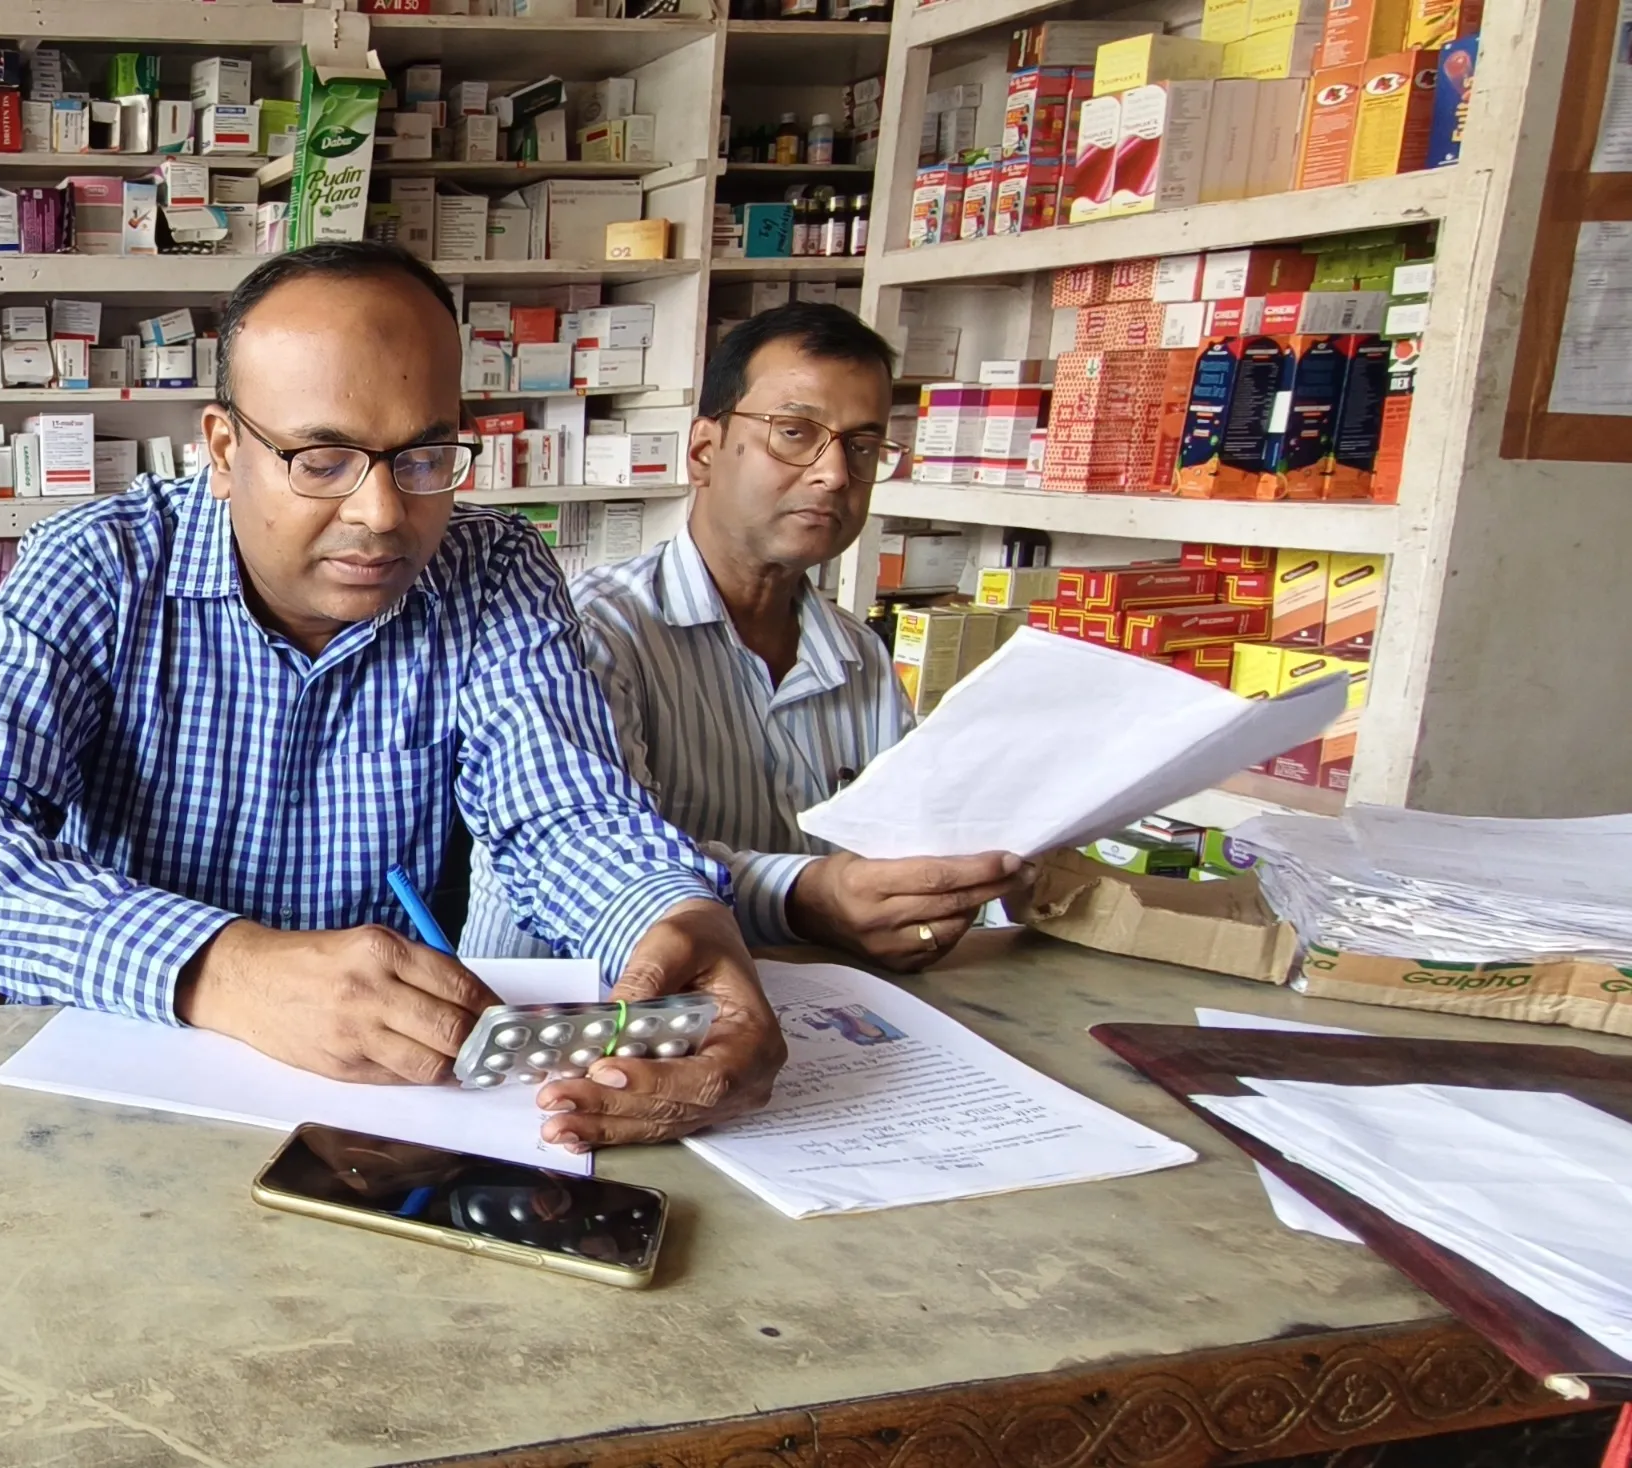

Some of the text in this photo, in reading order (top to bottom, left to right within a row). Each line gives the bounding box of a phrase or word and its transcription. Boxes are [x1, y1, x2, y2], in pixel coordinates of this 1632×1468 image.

[321, 135, 354, 150] Dabur
[307, 166, 362, 185] Pudin
[309, 186, 360, 206] Hara
[1401, 970, 1532, 991] Galpha
